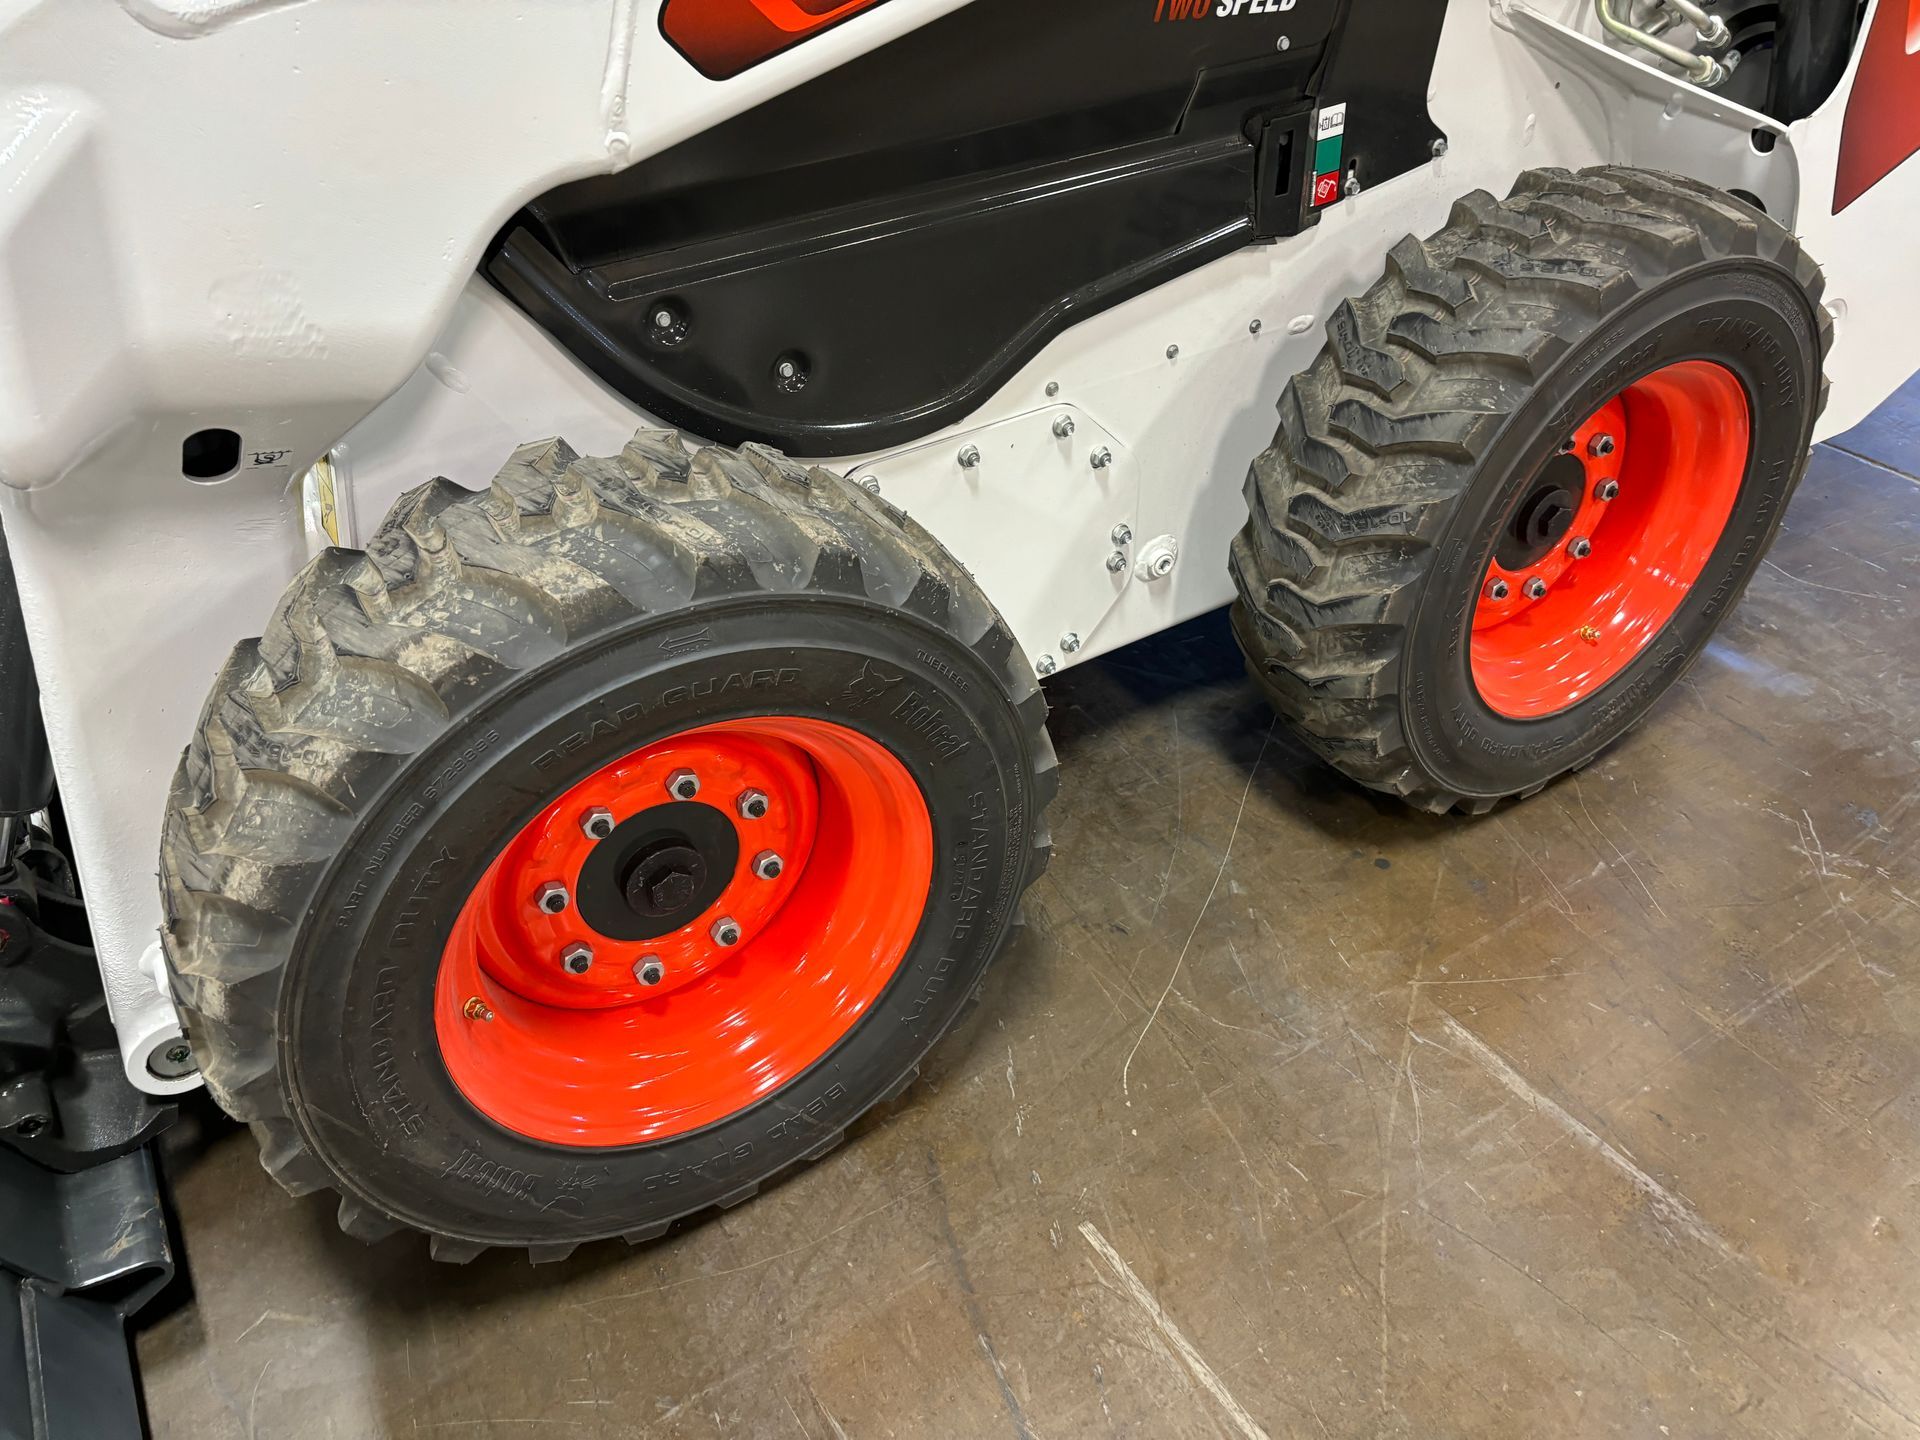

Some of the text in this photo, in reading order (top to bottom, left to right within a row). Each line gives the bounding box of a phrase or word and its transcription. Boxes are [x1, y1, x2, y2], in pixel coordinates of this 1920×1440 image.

[662, 667, 803, 708] GUARD
[916, 648, 970, 694] TUBELESS
[335, 878, 369, 930] PART
[364, 801, 426, 877] NUMBER
[388, 844, 461, 950] DUTY
[640, 1140, 755, 1193] GUARD
